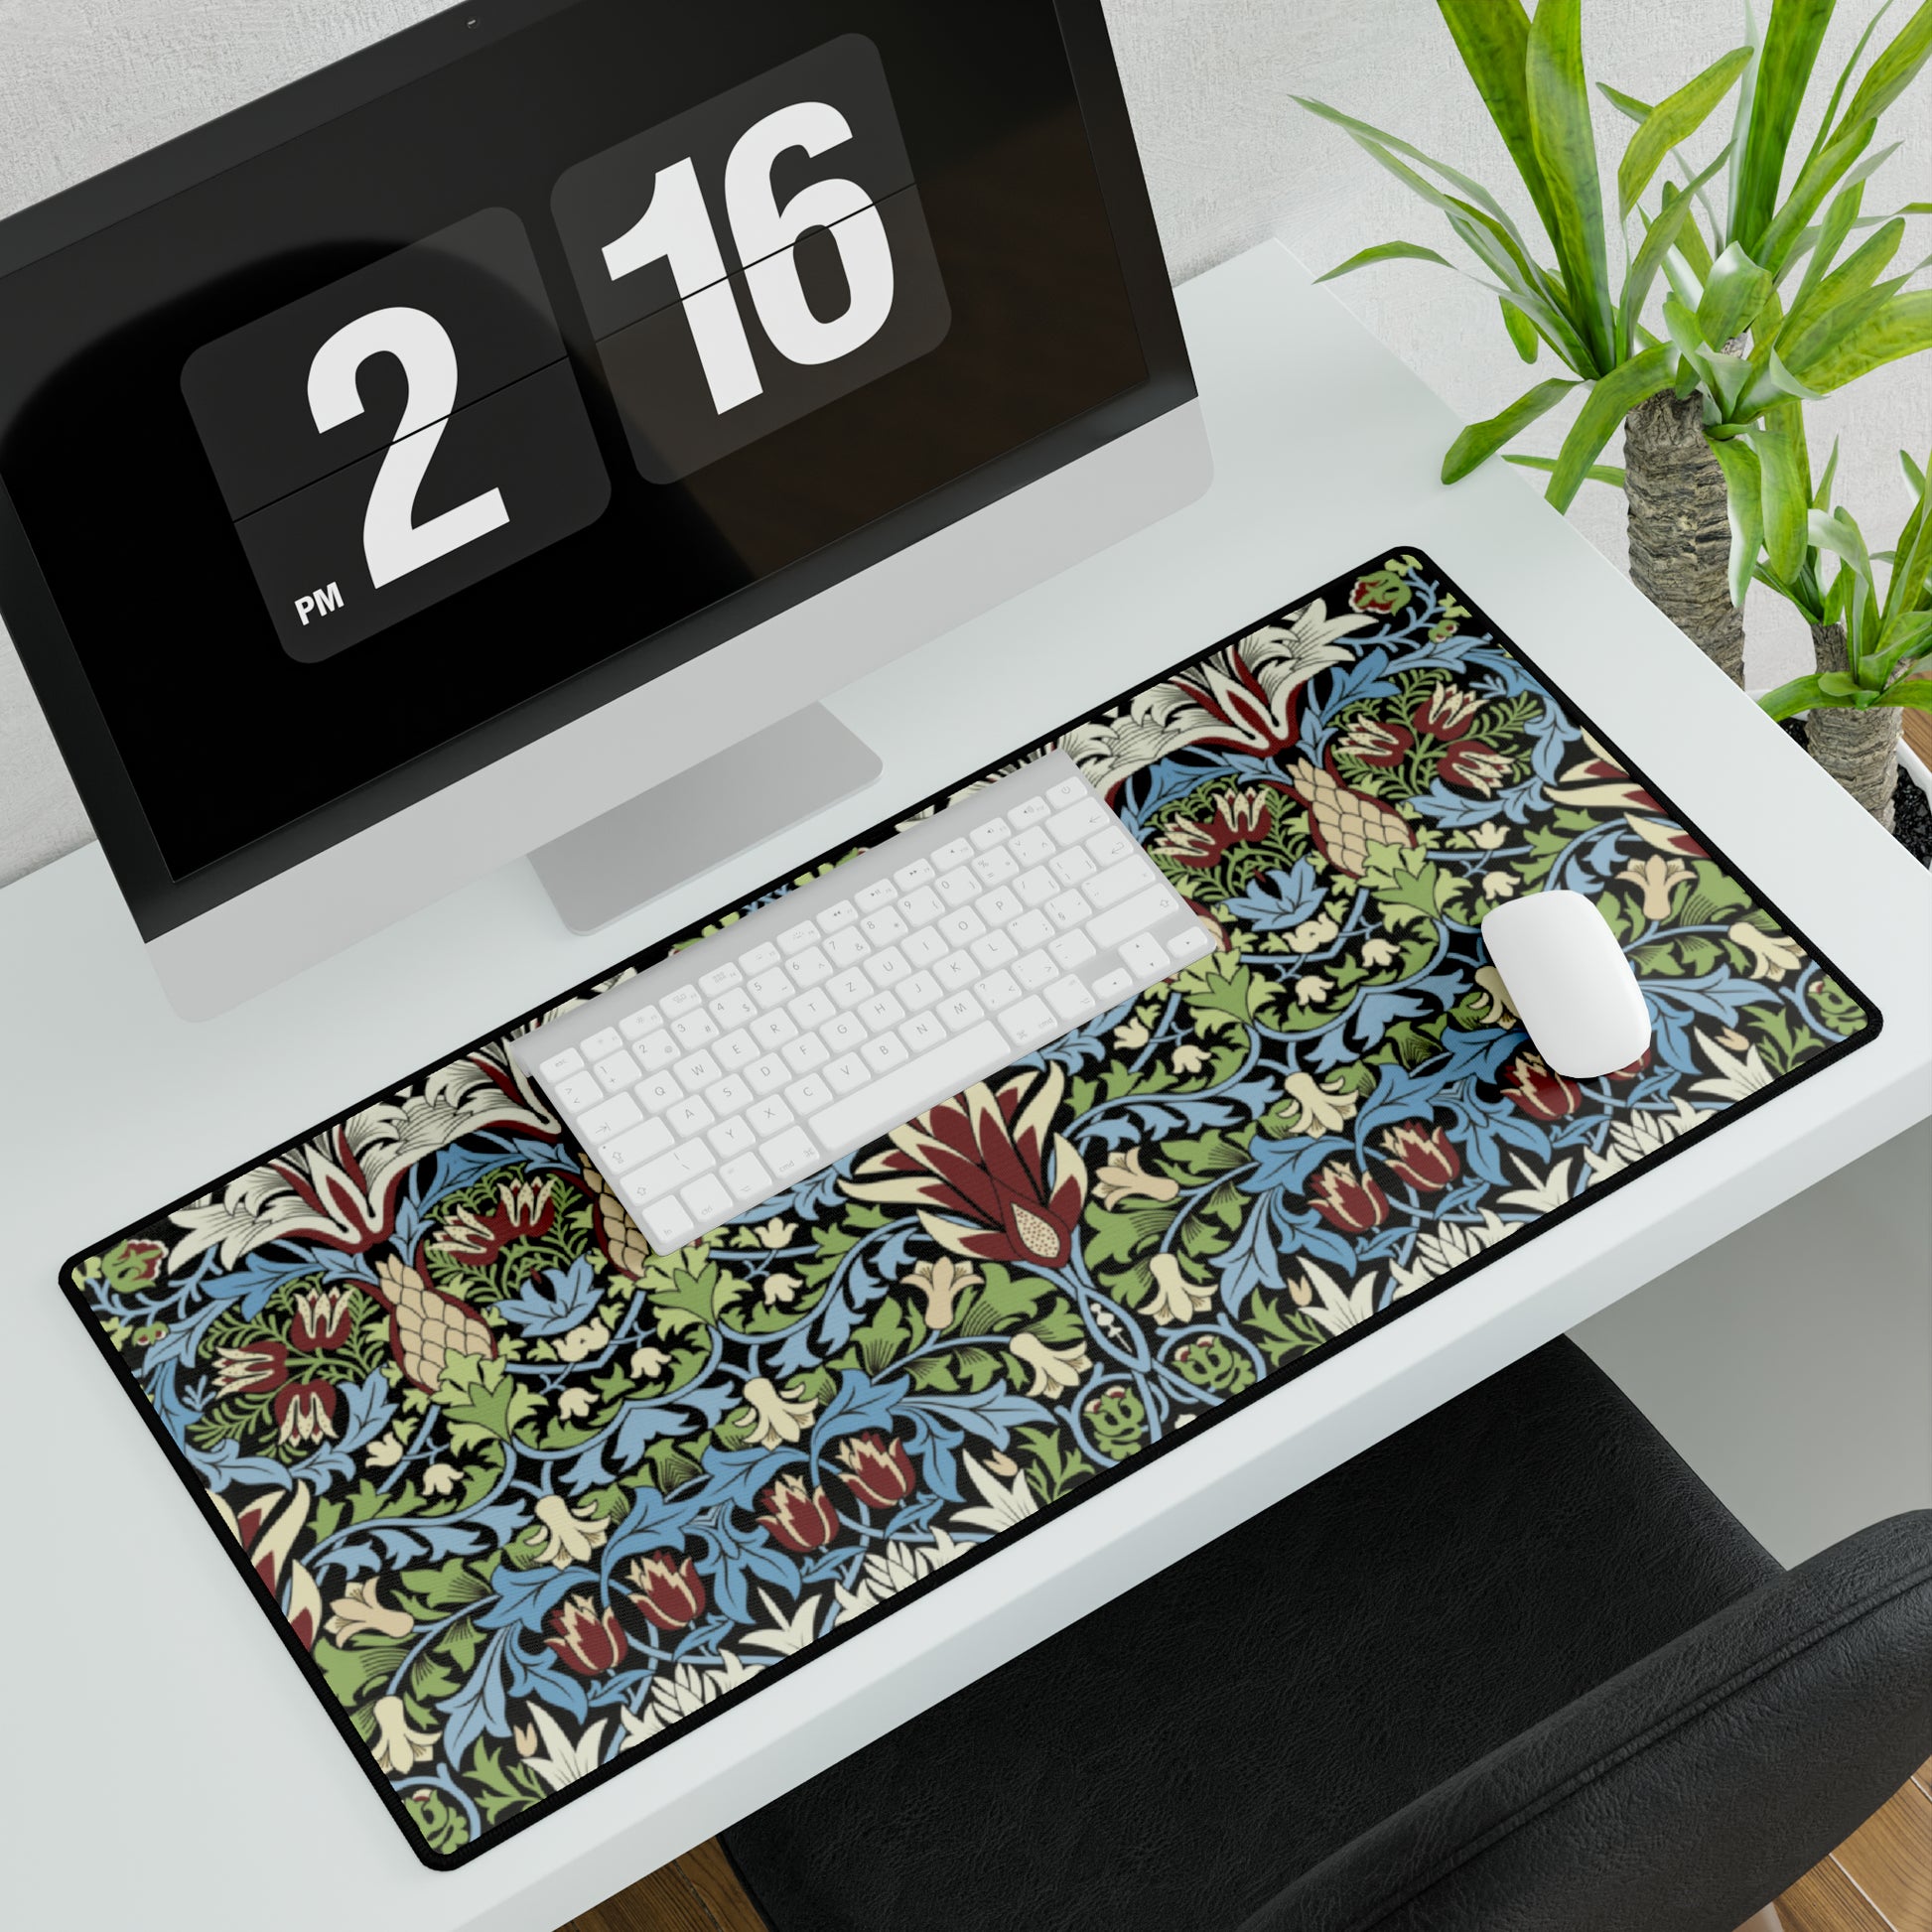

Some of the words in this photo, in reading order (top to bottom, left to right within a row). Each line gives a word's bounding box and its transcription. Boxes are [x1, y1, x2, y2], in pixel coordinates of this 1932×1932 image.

[308, 308, 510, 589] 2
[602, 102, 895, 415] 16
[295, 582, 345, 625] PM
[904, 900, 911, 910] 9
[995, 900, 1004, 910] P
[958, 921, 968, 930] O
[829, 940, 837, 950] 7
[792, 962, 800, 971] 6
[883, 961, 894, 972] U
[950, 963, 959, 972] K
[754, 982, 761, 991] 5
[846, 982, 856, 992] Z
[915, 984, 921, 993] J
[717, 1003, 725, 1012] 4
[807, 1003, 816, 1012] T
[874, 1004, 886, 1014] H
[954, 1003, 966, 1014] M
[677, 1024, 686, 1033] 3
[770, 1025, 779, 1034] R
[837, 1025, 848, 1035] G
[916, 1024, 928, 1034] N
[638, 1044, 647, 1054] 2
[732, 1044, 741, 1054] E
[799, 1045, 807, 1055] F
[879, 1045, 889, 1055] B
[691, 1064, 704, 1076] W
[760, 1066, 770, 1076] D
[841, 1065, 850, 1075] V
[654, 1086, 666, 1096] Q
[723, 1088, 732, 1097] S
[803, 1087, 813, 1096] C
[685, 1109, 694, 1119] A
[764, 1108, 775, 1118] X
[726, 1129, 734, 1138] Y
